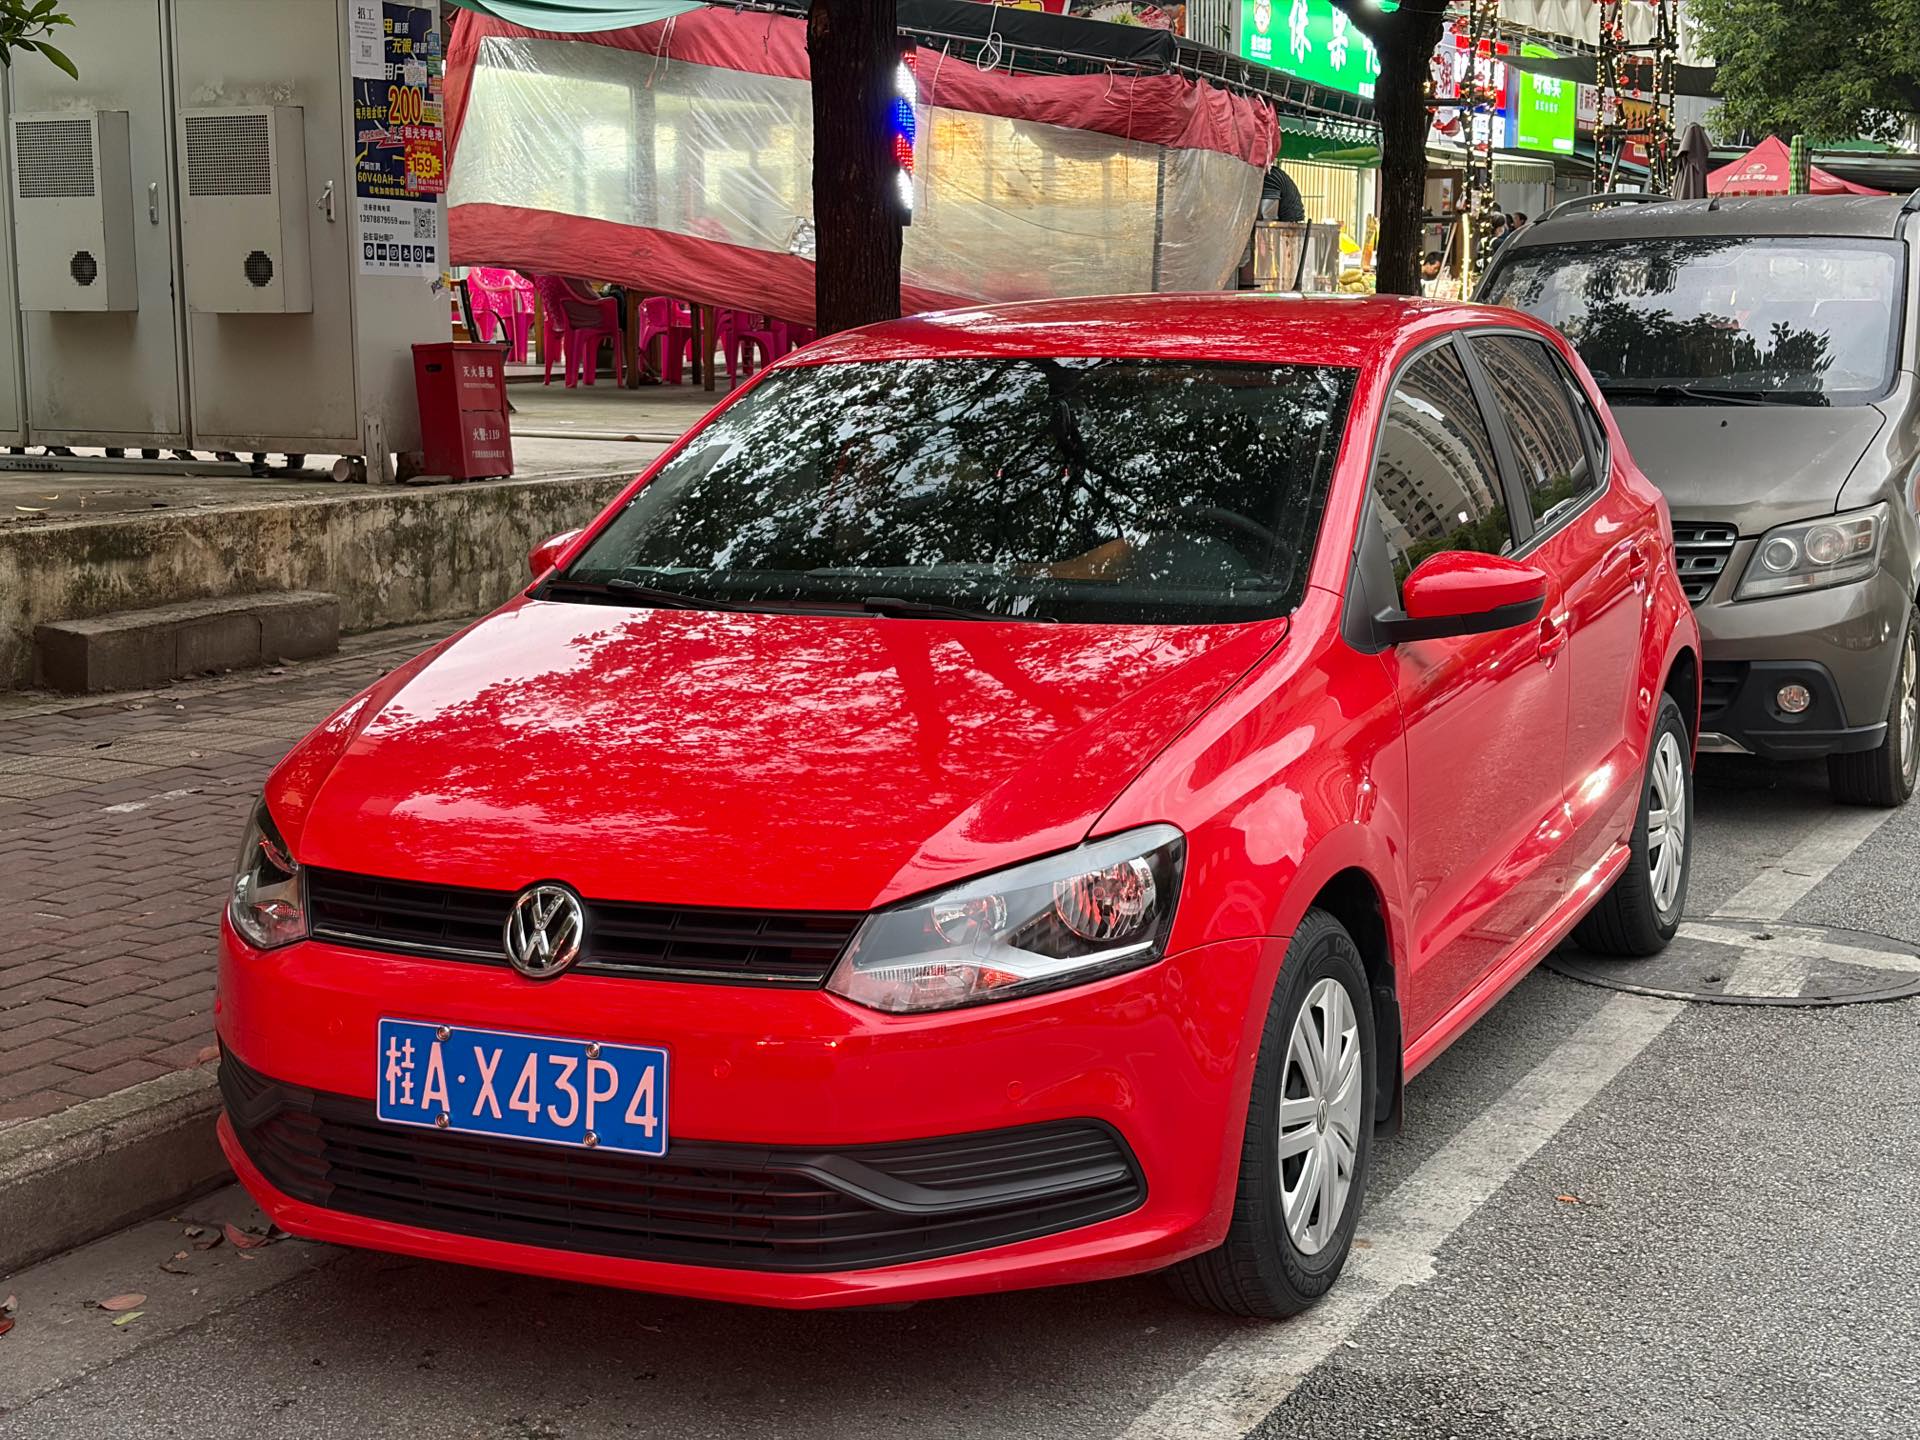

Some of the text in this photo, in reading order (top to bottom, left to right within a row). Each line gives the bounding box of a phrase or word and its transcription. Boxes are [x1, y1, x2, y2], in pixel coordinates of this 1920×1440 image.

[388, 85, 423, 125] 200
[413, 158, 432, 173] 159
[463, 365, 494, 378] 灭火器箱
